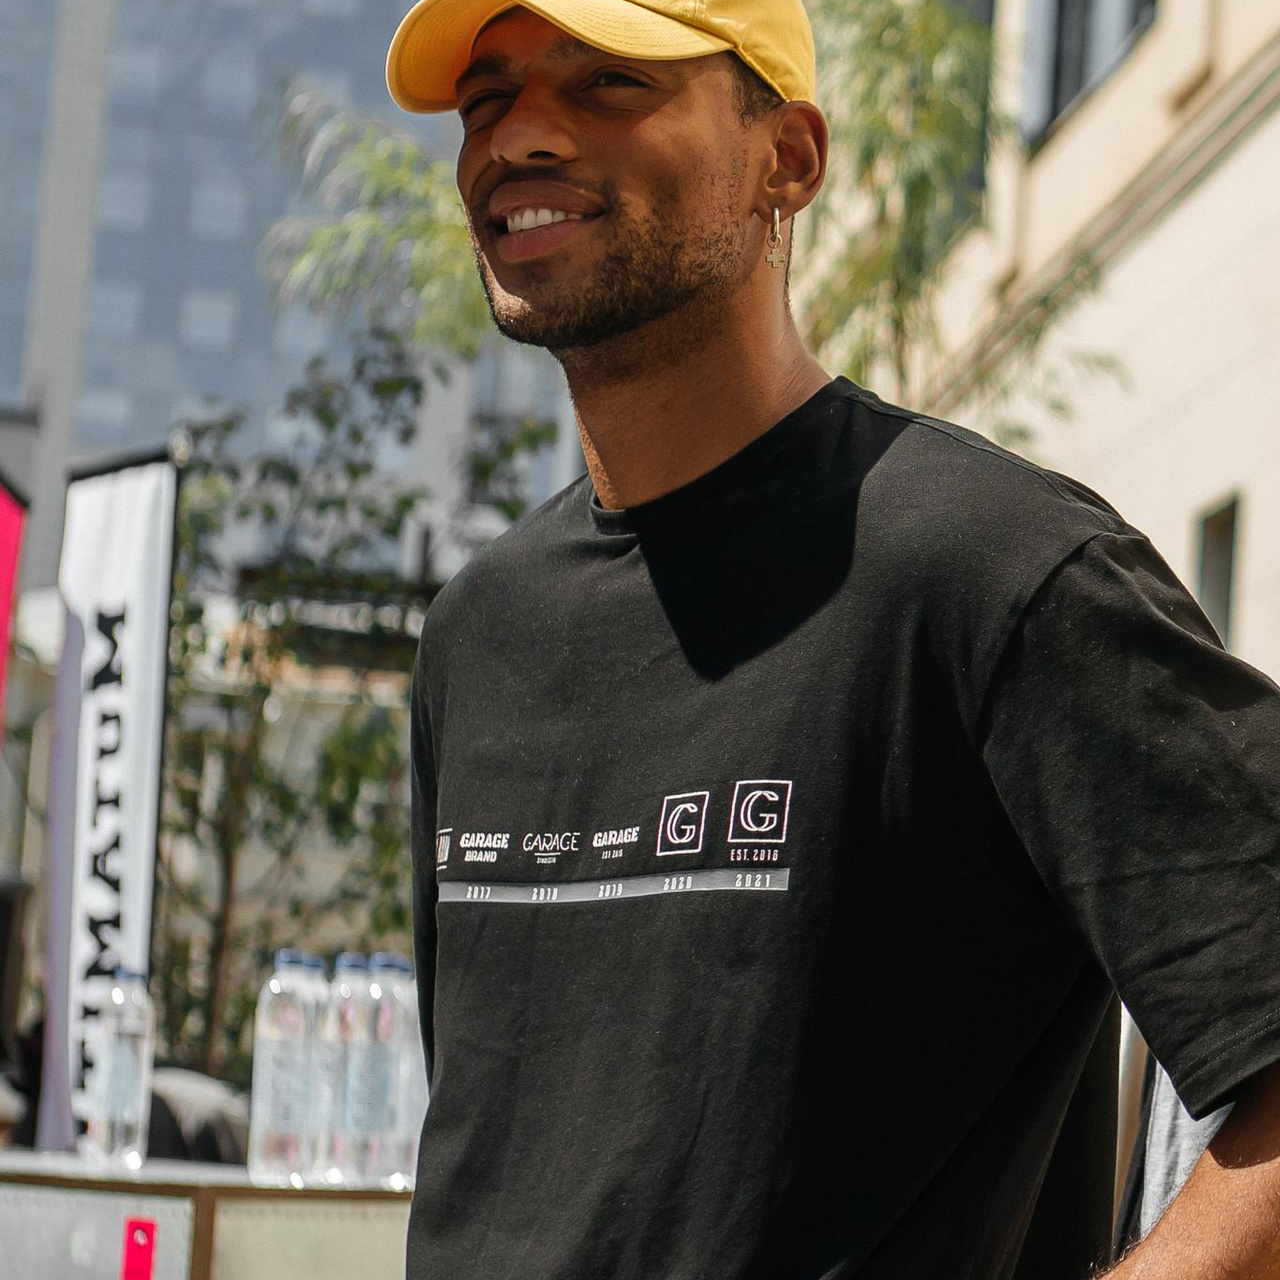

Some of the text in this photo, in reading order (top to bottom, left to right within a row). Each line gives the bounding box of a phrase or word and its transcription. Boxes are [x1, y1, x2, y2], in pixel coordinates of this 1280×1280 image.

[459, 832, 510, 849] GARAGE
[522, 832, 580, 851] GARAGE
[592, 826, 640, 847] GARAGE
[666, 802, 699, 844] G
[740, 790, 779, 831] G
[464, 850, 498, 863] BRAND
[730, 848, 779, 861] EST. 2016
[466, 873, 771, 901] 2017 2018 2019 2020 2021
